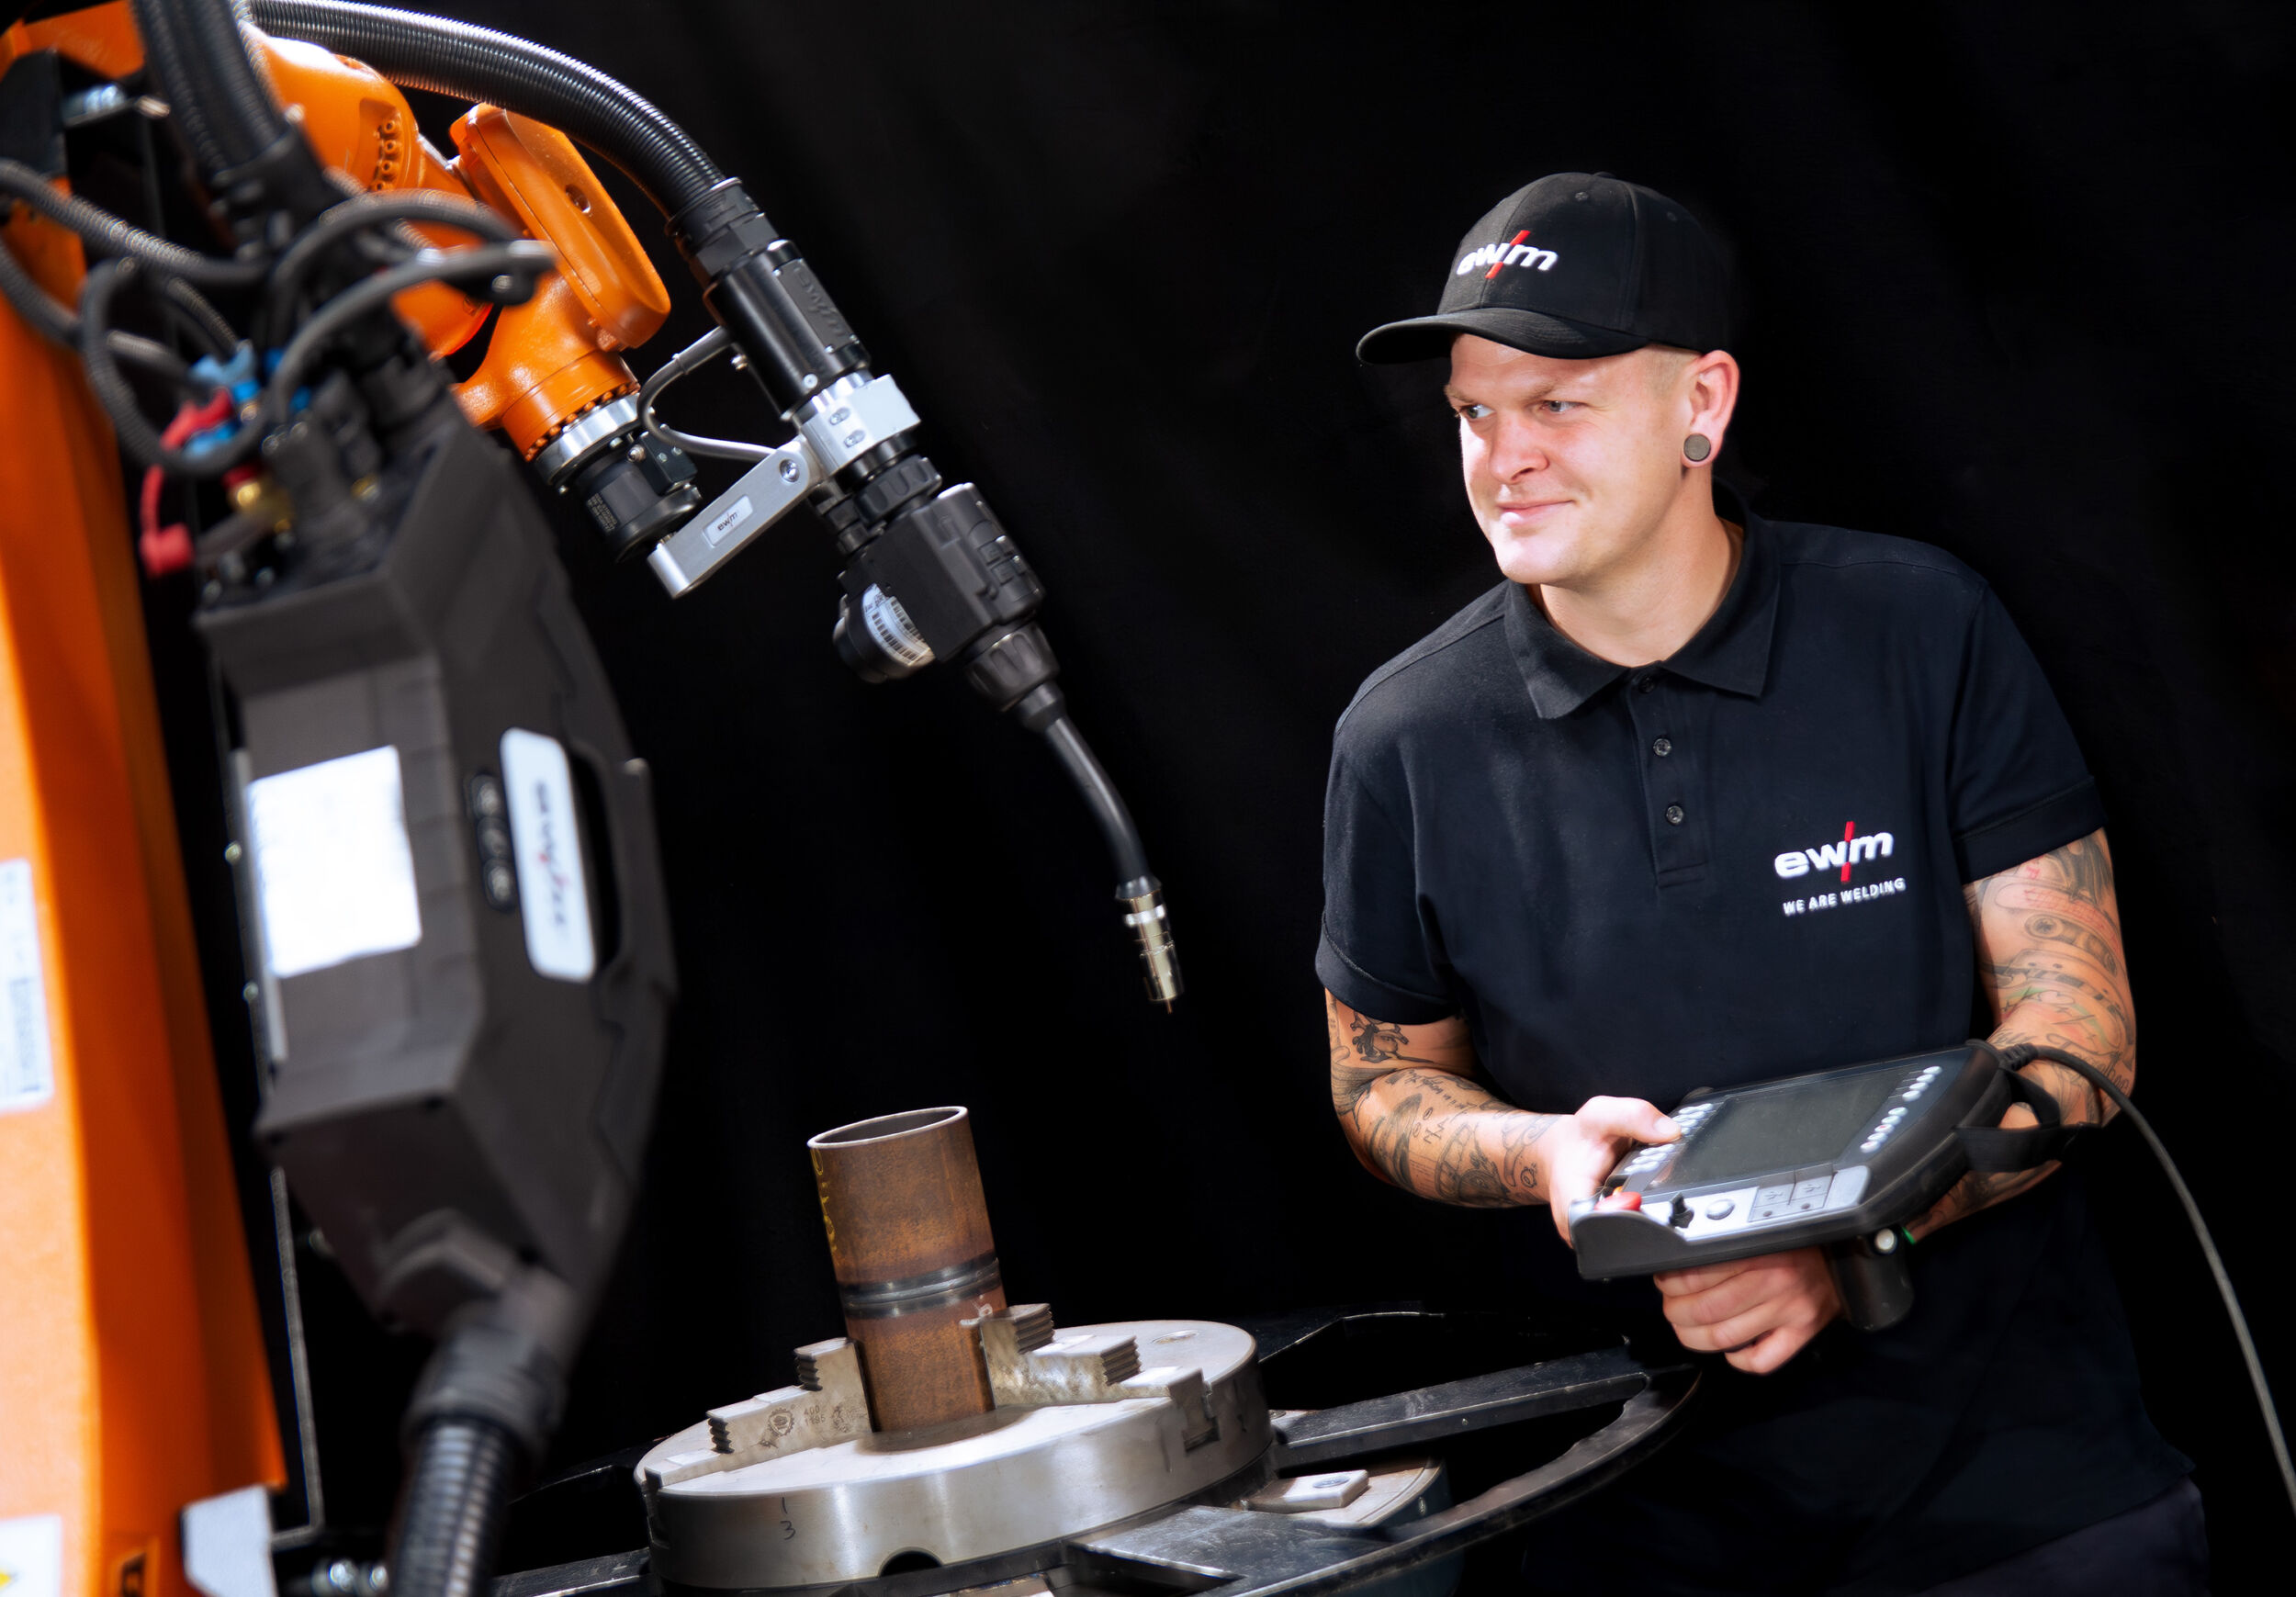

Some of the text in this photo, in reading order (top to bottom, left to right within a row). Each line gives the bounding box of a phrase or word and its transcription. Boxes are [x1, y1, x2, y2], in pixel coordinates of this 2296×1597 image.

[1774, 820, 1894, 883] ewm
[1783, 877, 1907, 917] WE ARE WELDING
